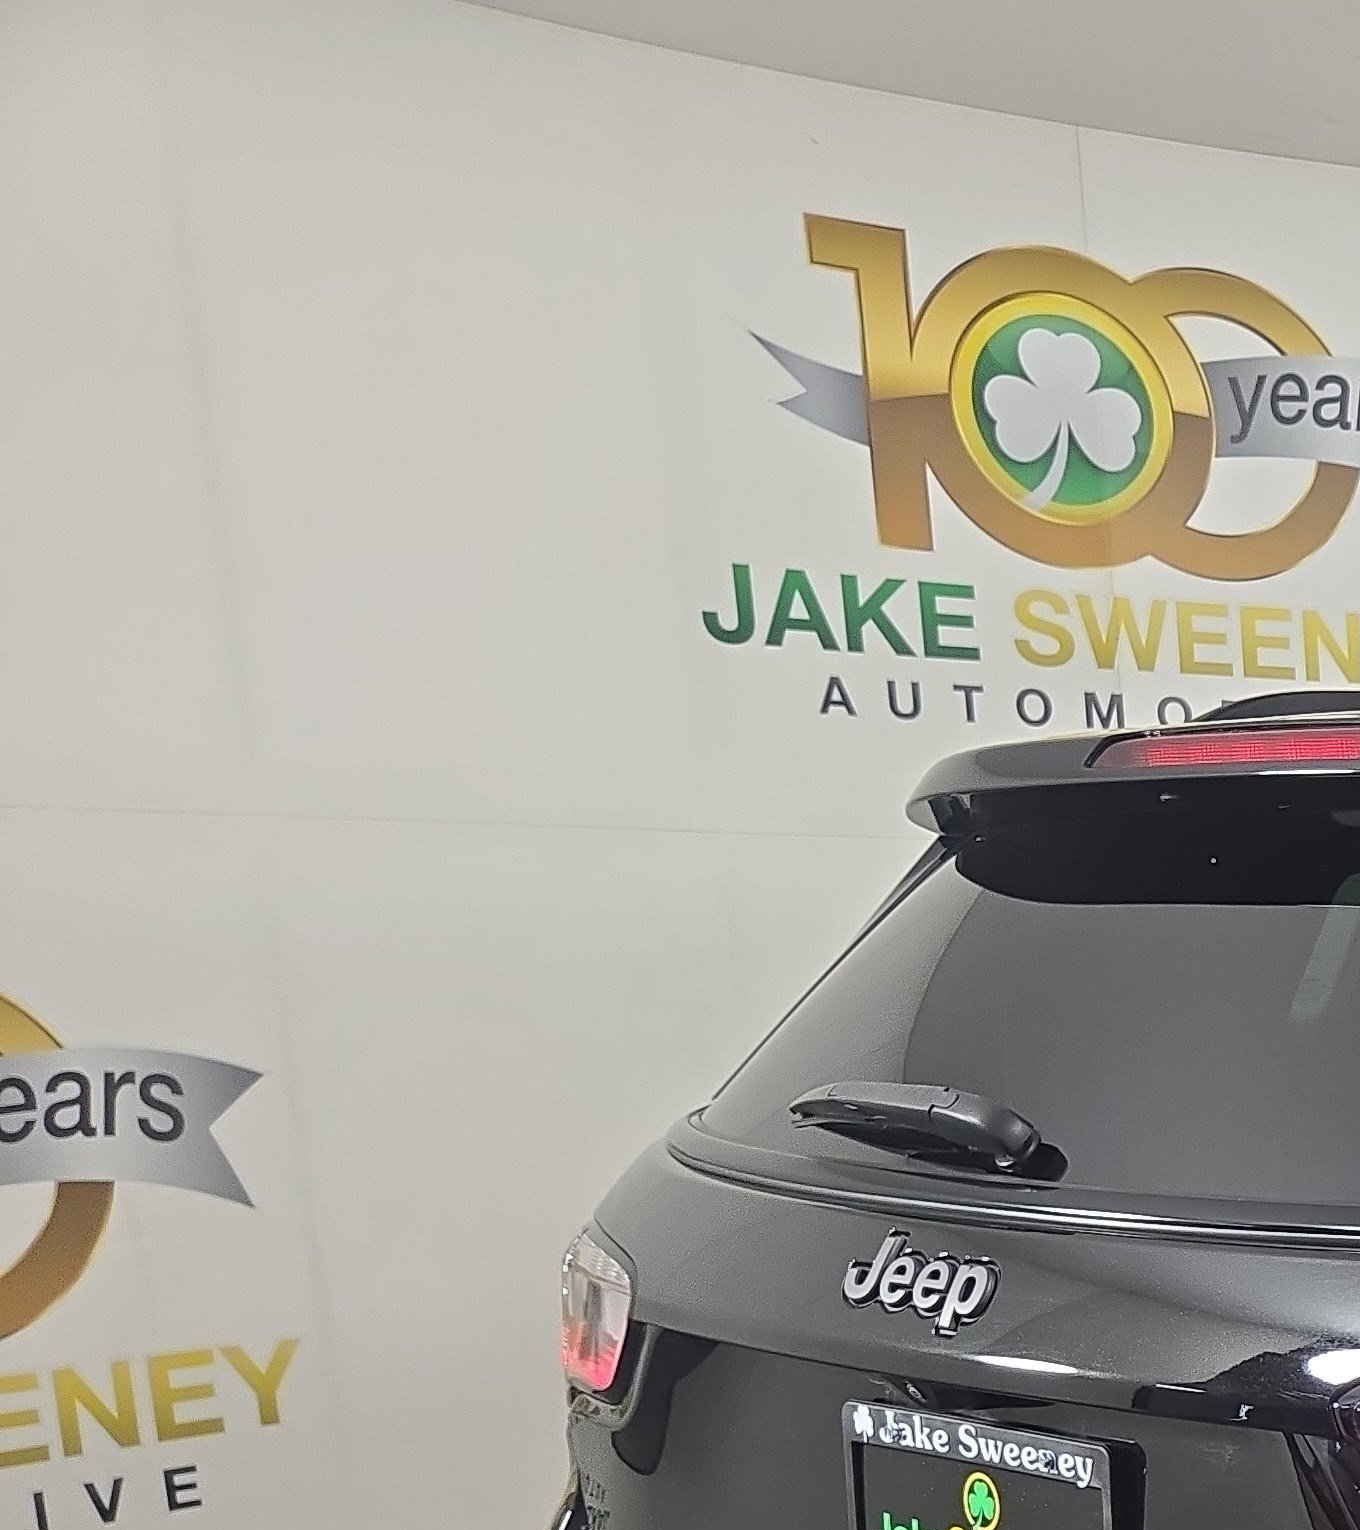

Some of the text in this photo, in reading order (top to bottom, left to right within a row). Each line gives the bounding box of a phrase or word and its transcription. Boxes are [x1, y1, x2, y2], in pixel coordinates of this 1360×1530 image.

[701, 562, 981, 662] JAKE
[819, 675, 1239, 730] AUTOMO
[0, 1068, 186, 1144] ears
[842, 1228, 1000, 1337] Jeep
[878, 1409, 951, 1454] Jake
